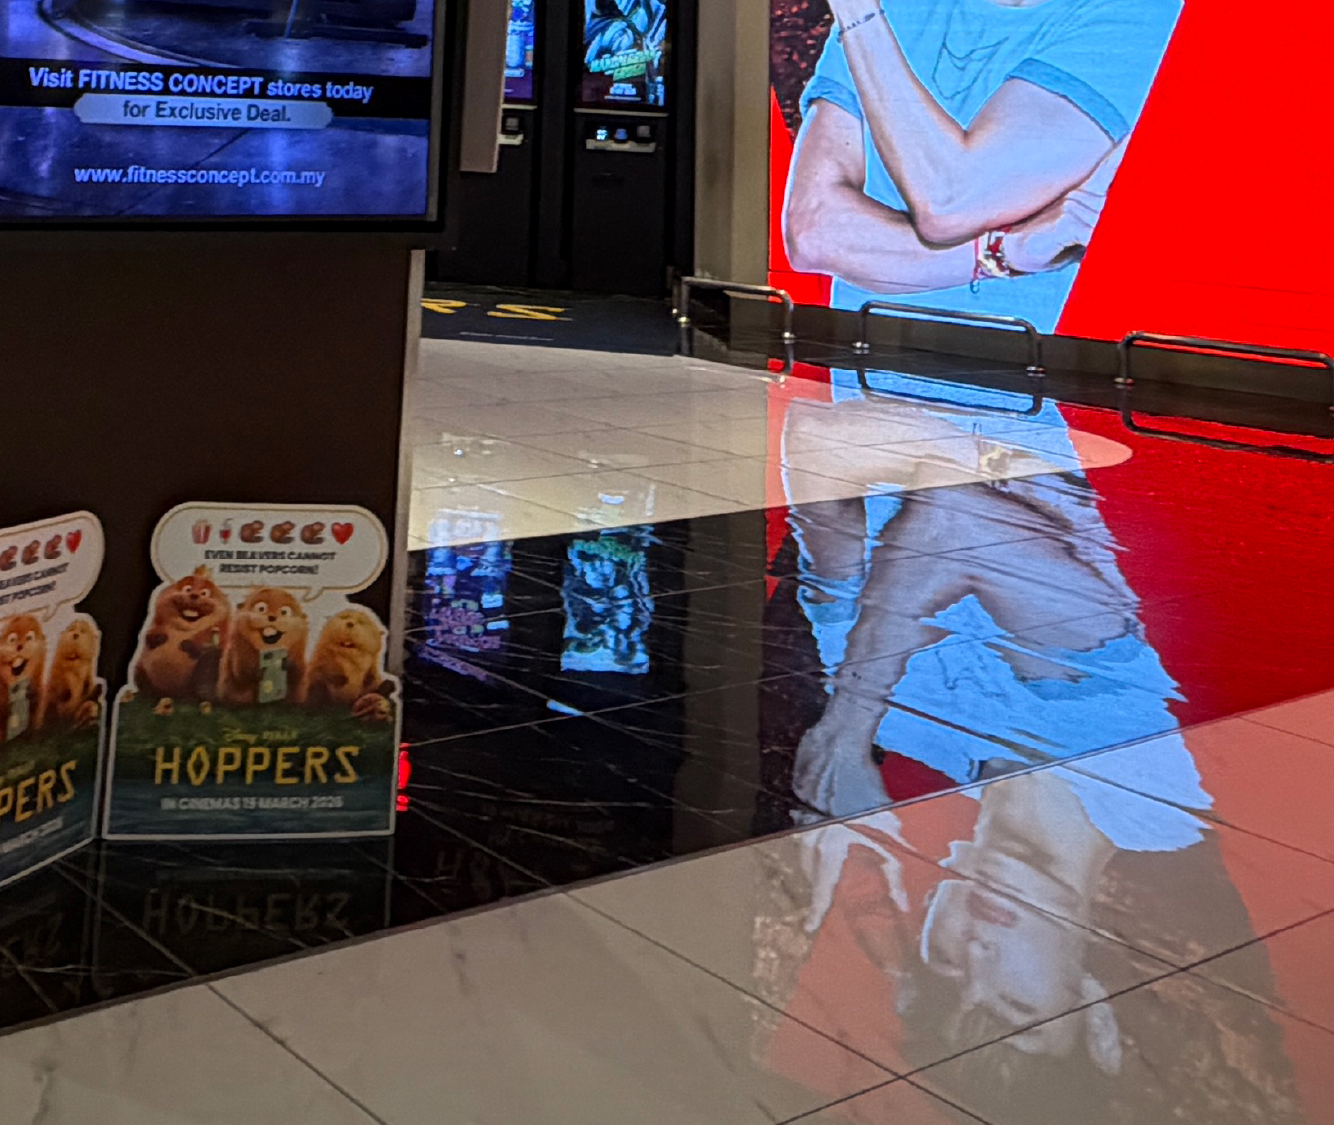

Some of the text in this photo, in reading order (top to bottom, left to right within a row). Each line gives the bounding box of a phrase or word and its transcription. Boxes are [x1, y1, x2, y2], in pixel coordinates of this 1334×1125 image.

[29, 67, 373, 104] Visit FITNESS CONCEPT stores today
[123, 100, 291, 123] for Exclusive Deal.
[74, 164, 326, 188] www.fitnessconcept.com.my
[205, 550, 336, 561] EVEN BEAVERS CANNOT
[219, 564, 257, 573] RESIST
[154, 745, 361, 786] HOPPERS
[161, 797, 175, 810] IN
[178, 797, 240, 810] CINEMAS
